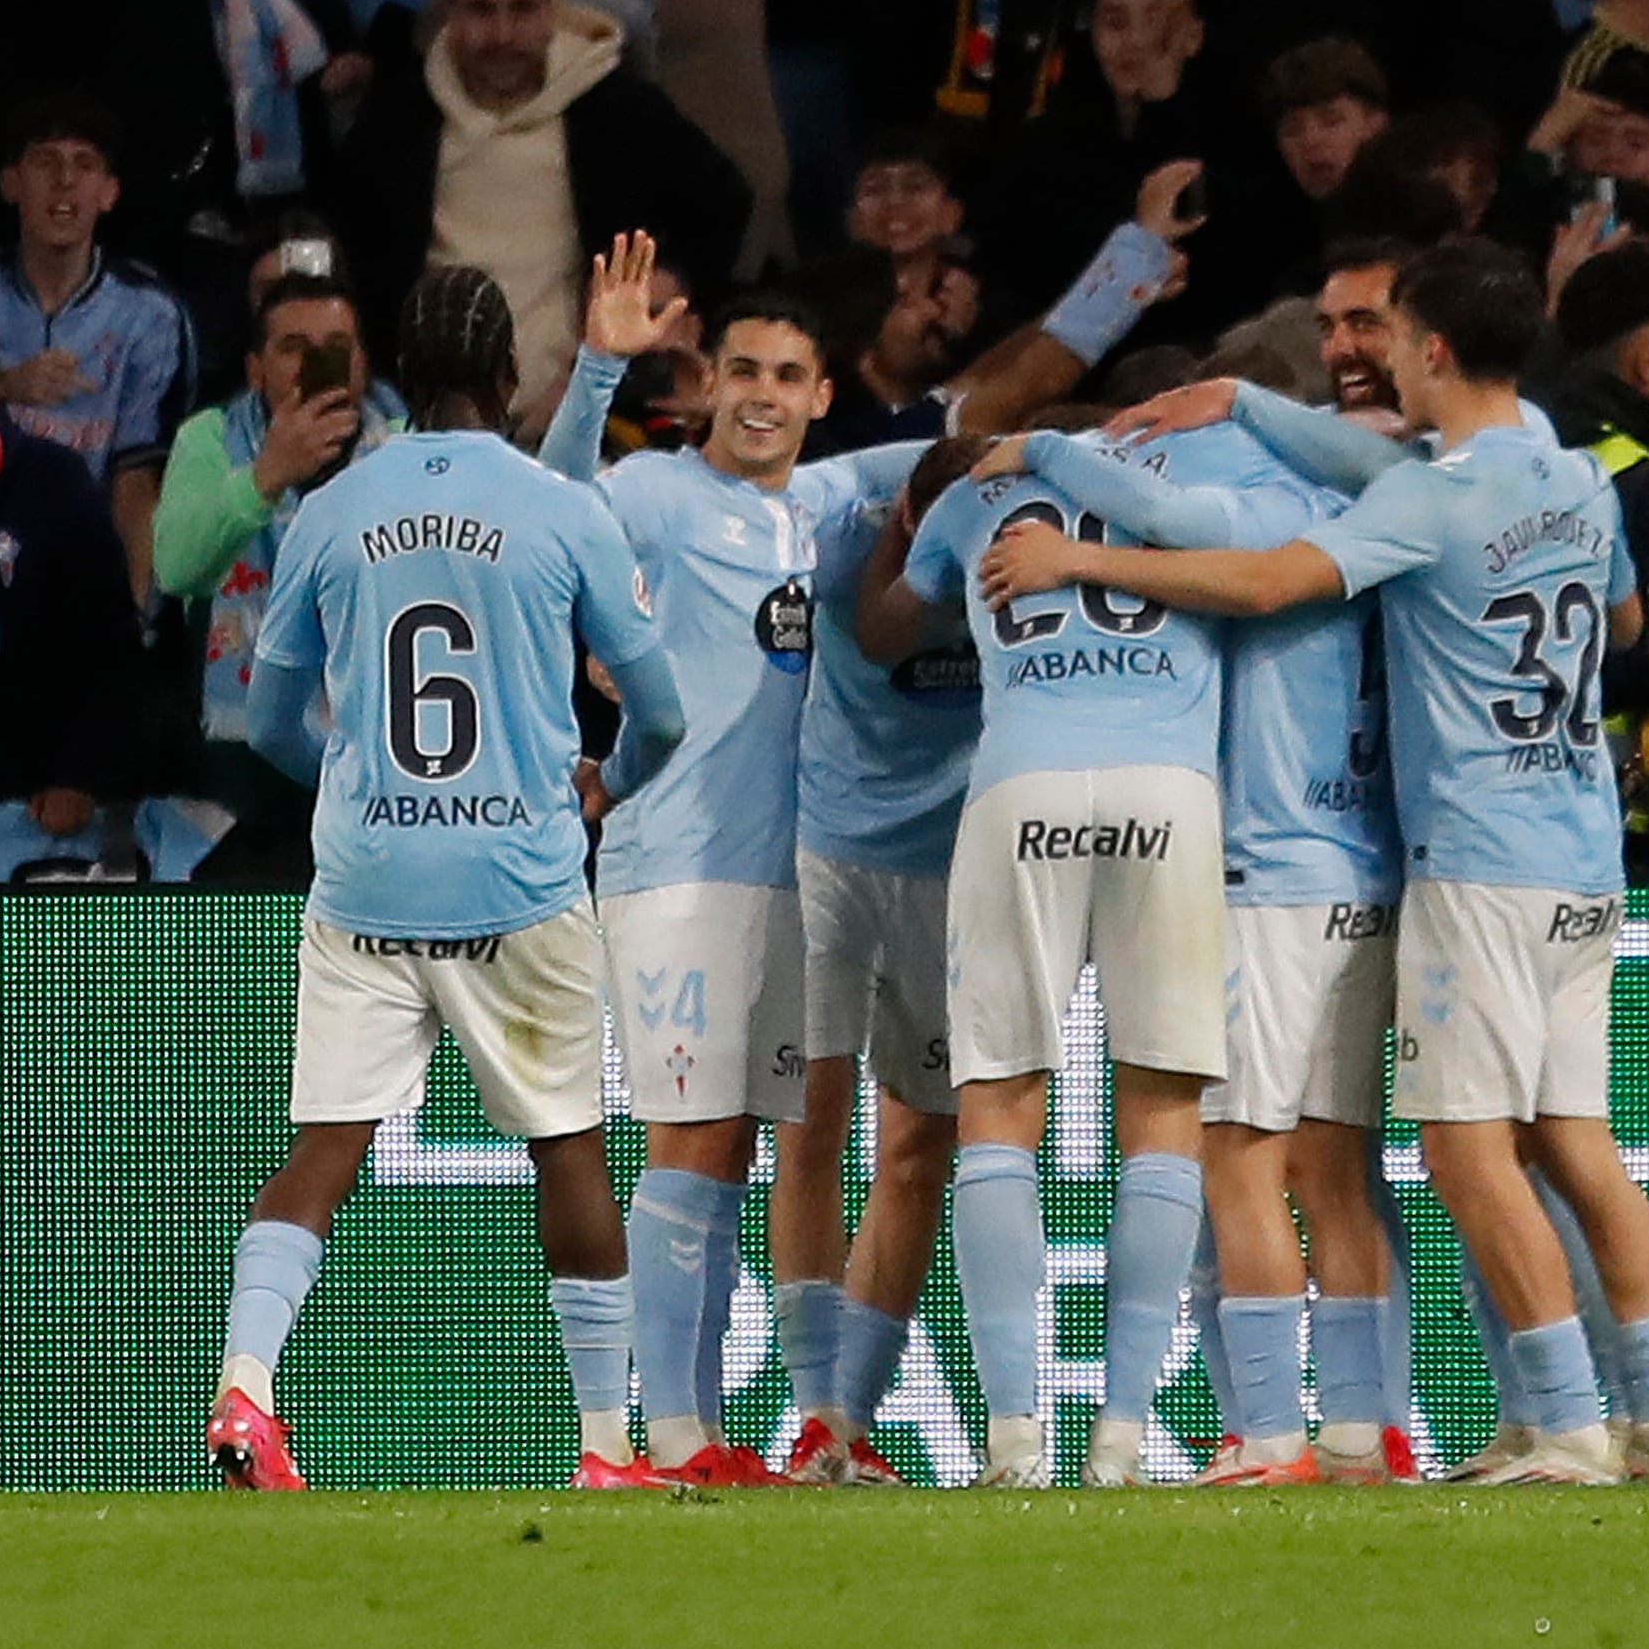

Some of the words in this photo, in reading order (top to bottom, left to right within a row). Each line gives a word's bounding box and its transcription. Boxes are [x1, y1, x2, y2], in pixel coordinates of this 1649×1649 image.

[361, 514, 505, 564] MORIBA
[1007, 645, 1178, 689] ABANCA
[1480, 583, 1599, 746] 32
[385, 600, 481, 784] 6
[361, 794, 534, 828] ABANCA
[1016, 818, 1175, 862] Recalvi
